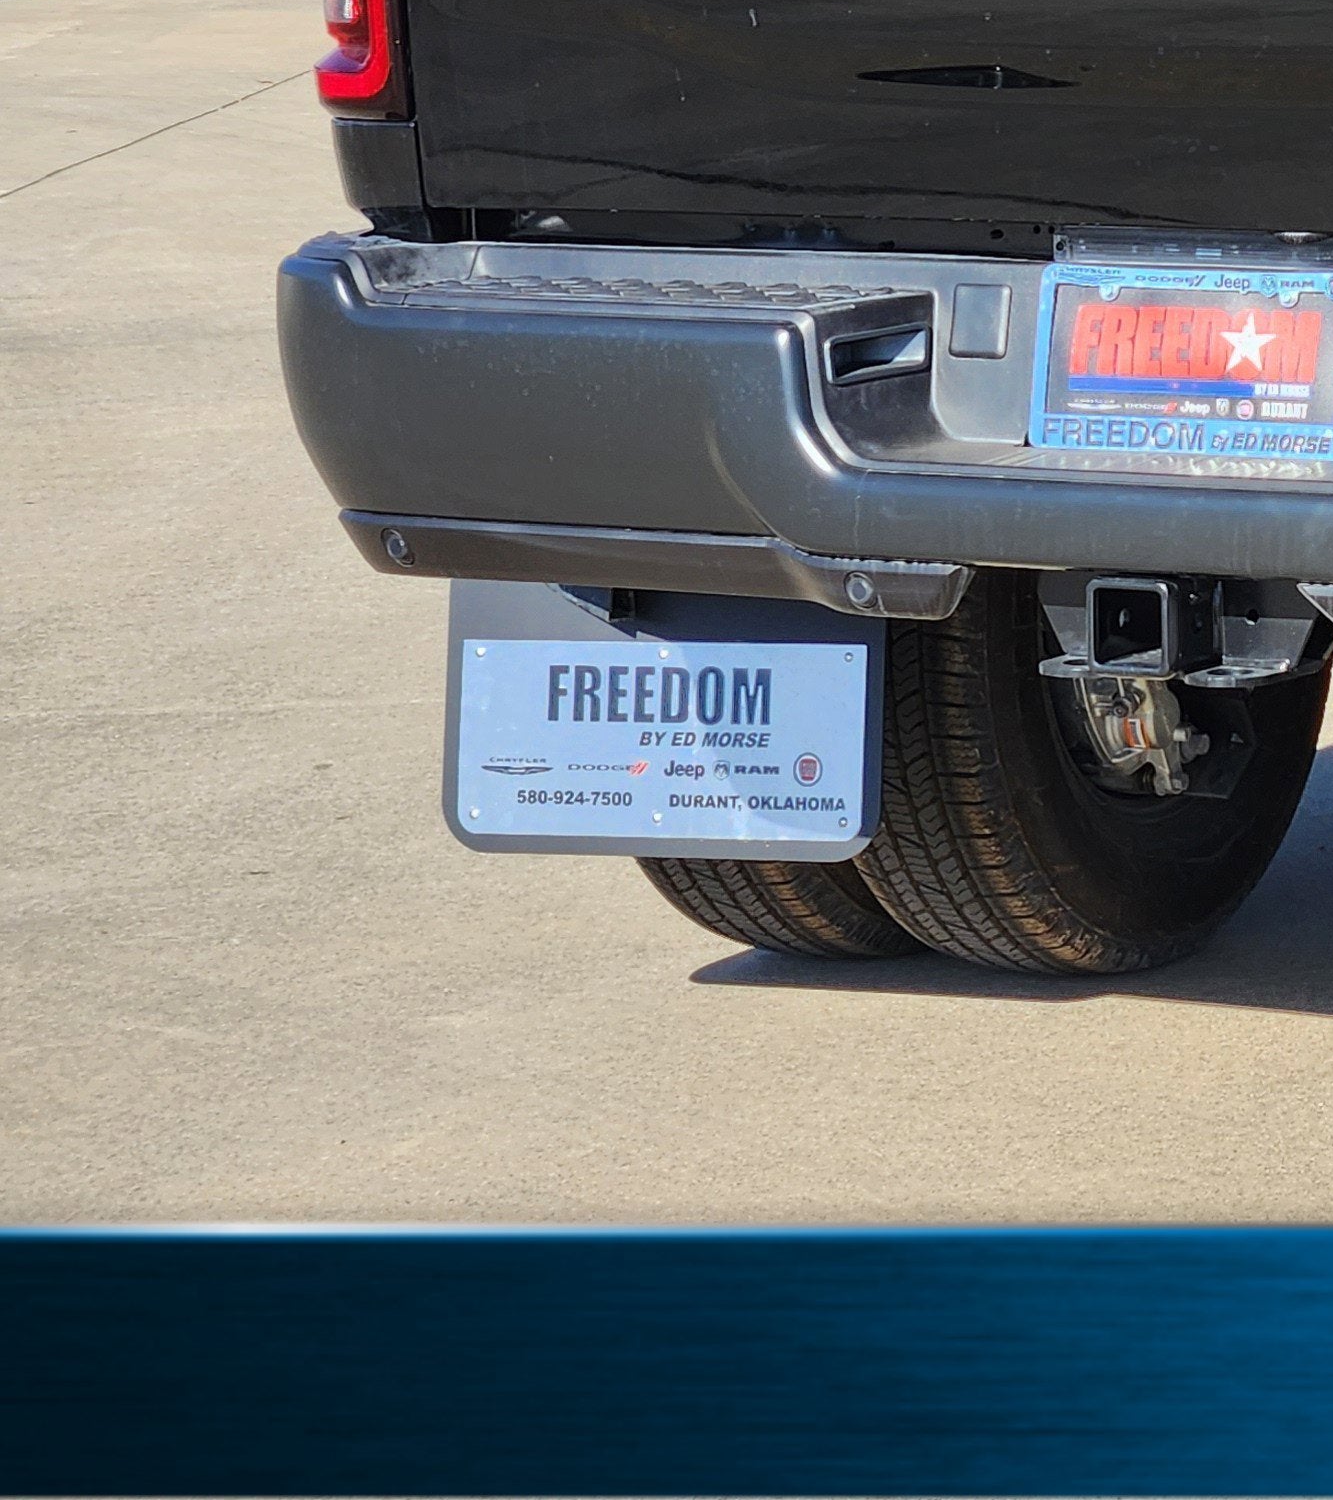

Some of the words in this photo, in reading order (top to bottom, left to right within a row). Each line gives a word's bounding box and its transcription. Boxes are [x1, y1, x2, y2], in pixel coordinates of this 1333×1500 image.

[1214, 273, 1251, 290] Jeep
[1279, 280, 1316, 289] RAM
[1069, 303, 1322, 384] FREEDOM
[1042, 417, 1206, 450] FREEDOM
[1231, 433, 1259, 450] ED
[1261, 434, 1332, 454] MORSE
[547, 664, 772, 726] FREEDOM
[639, 731, 666, 747] BY
[671, 732, 697, 748] ED
[700, 732, 772, 749] MORSE
[664, 760, 706, 781] Jeep
[734, 765, 780, 776] RAM
[517, 789, 633, 807] 580-924-7500
[669, 794, 743, 812] DURANT,
[747, 796, 846, 812] OKLAHOMA
